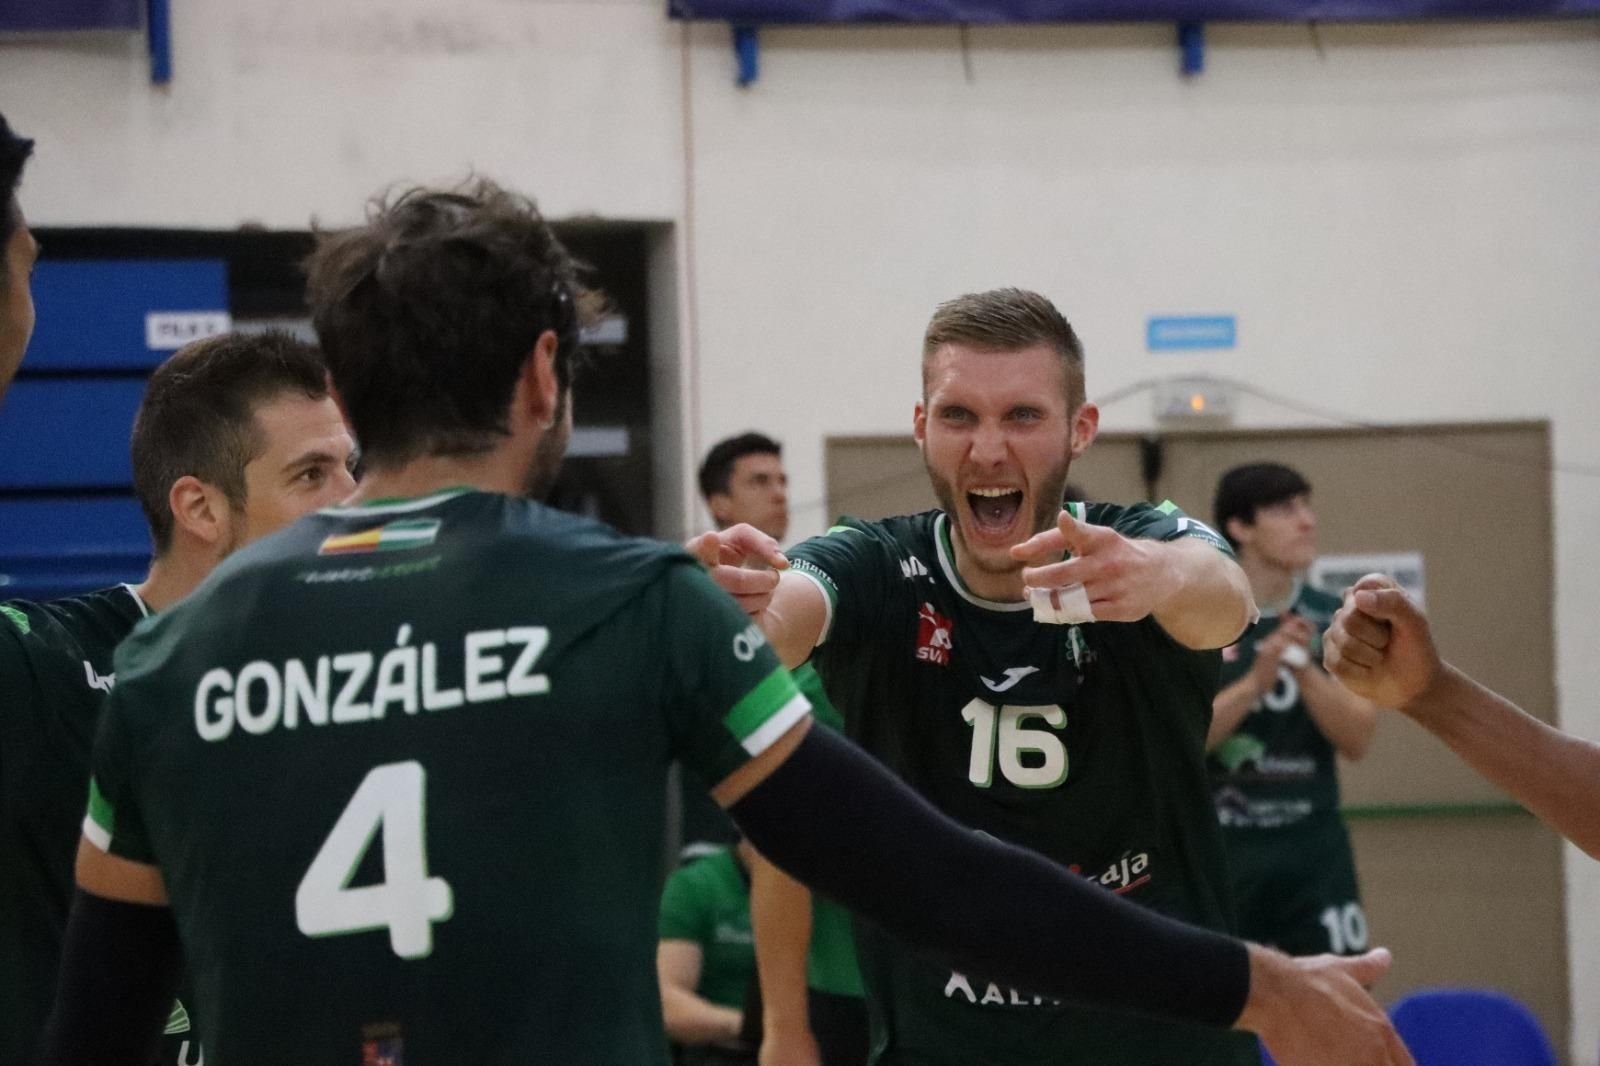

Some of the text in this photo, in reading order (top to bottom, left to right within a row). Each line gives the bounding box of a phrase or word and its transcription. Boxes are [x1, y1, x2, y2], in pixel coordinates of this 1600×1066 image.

[194, 624, 551, 741] GONZÁLEZ
[960, 696, 1069, 789] 16
[295, 759, 453, 959] 4
[1320, 902, 1367, 954] 10
